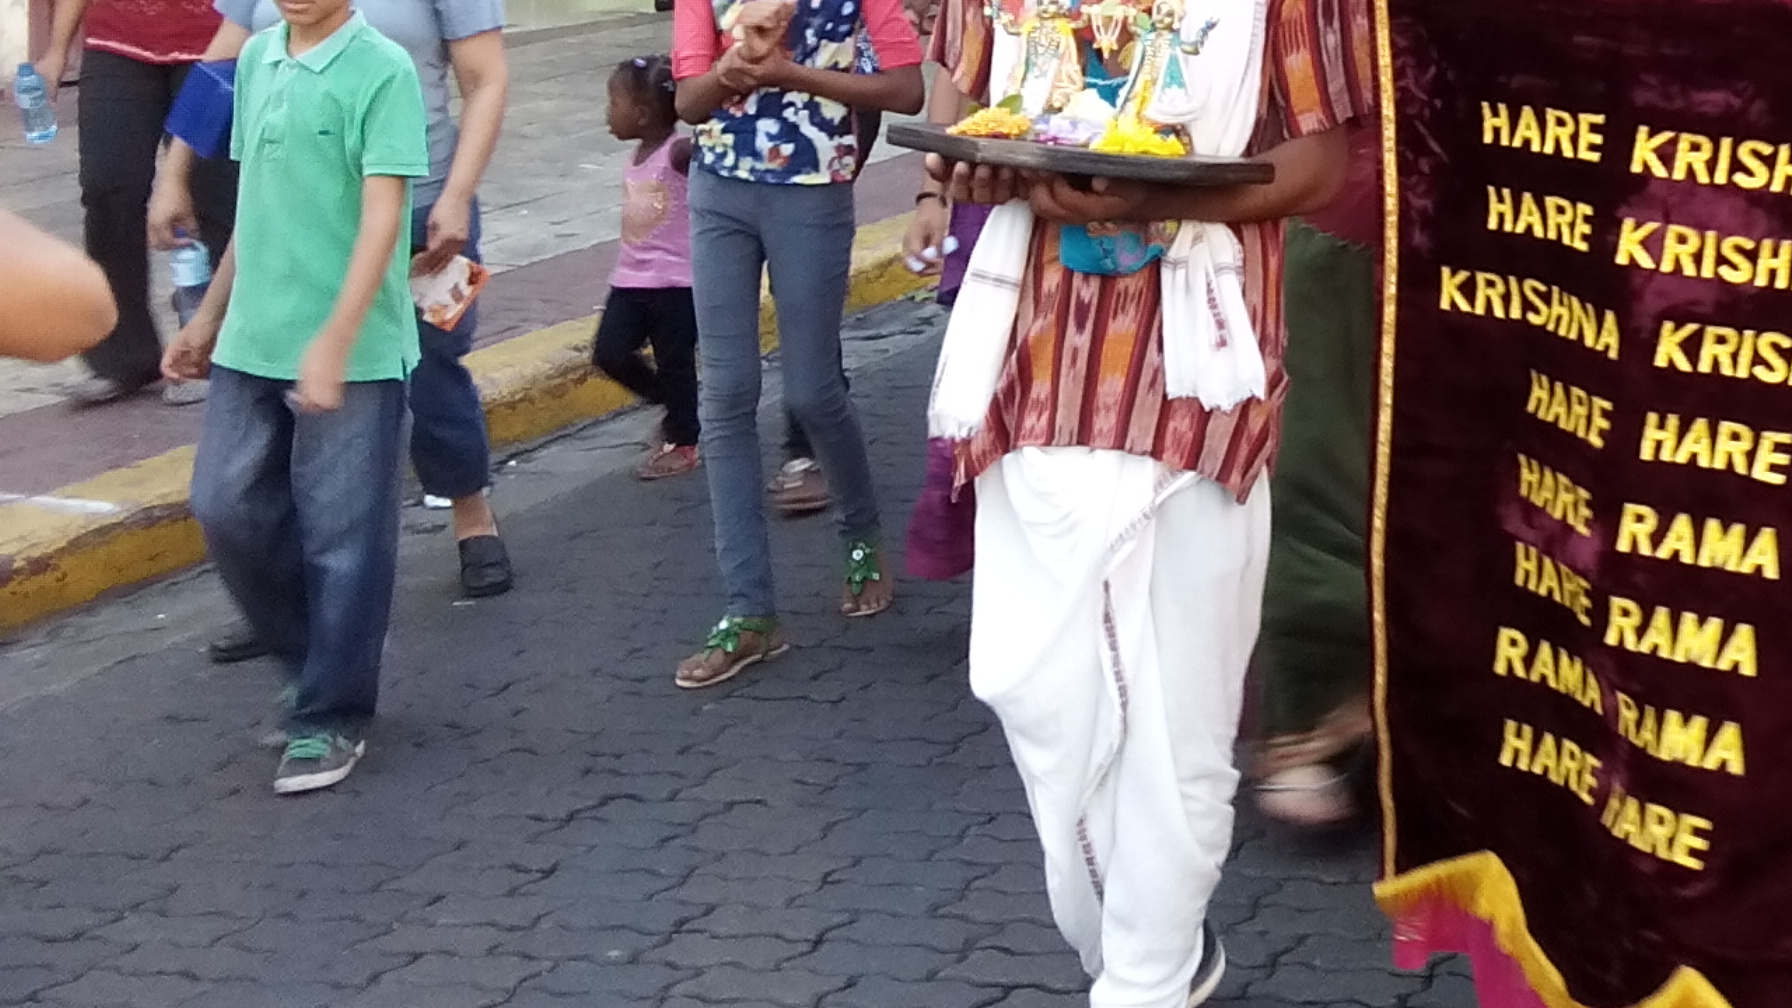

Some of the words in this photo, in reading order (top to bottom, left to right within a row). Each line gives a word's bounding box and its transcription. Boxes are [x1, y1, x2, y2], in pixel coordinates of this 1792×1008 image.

[1482, 101, 1606, 163] HARE
[1485, 185, 1594, 252] HARE
[1438, 265, 1621, 360] KRISHNA
[1526, 369, 1613, 449] HARE
[1517, 453, 1593, 537] HARE
[1615, 502, 1781, 580] RAMA
[1513, 541, 1592, 626] HARE
[1604, 595, 1758, 677] RAMA
[1492, 626, 1604, 715] RAMA
[1614, 691, 1746, 776] RAMA
[1498, 718, 1604, 806] HARE
